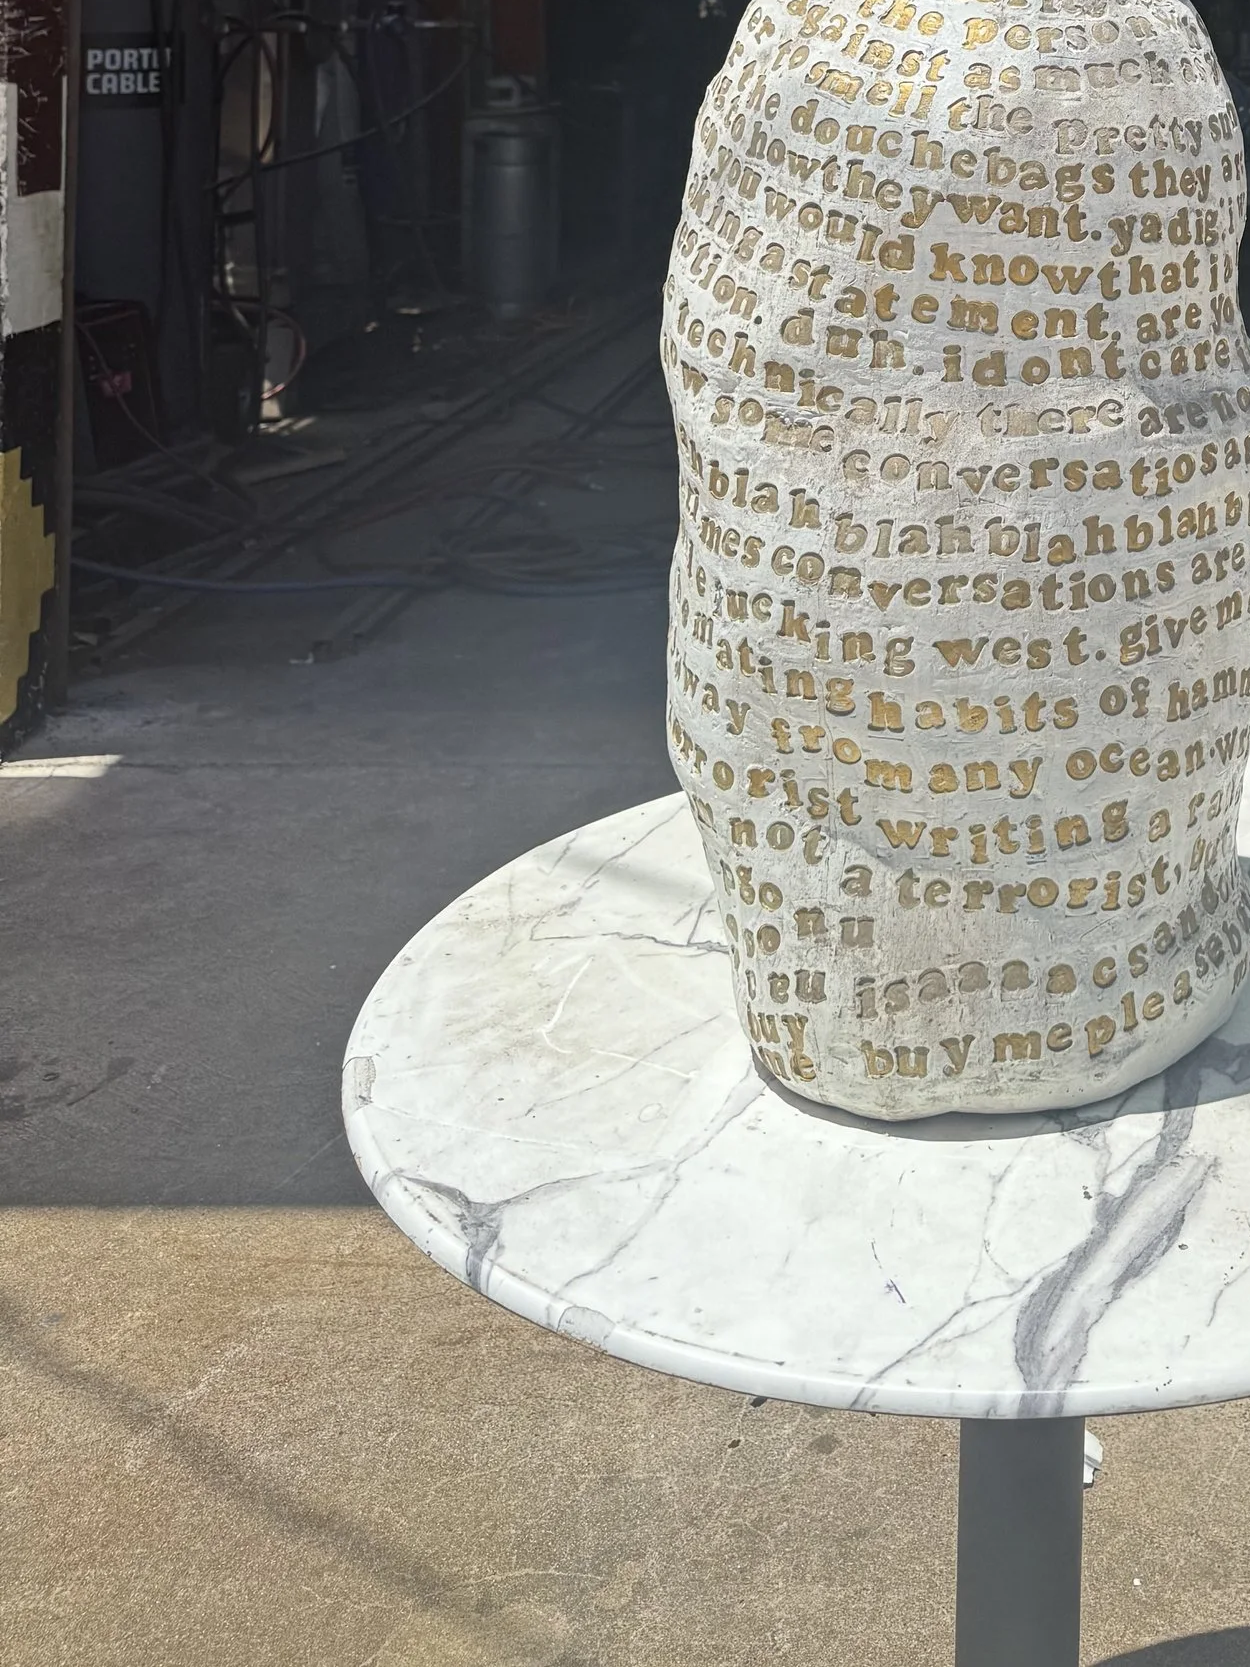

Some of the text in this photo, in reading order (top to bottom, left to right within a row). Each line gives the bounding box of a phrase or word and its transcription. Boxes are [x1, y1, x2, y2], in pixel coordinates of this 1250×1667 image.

[87, 47, 172, 70] PORT
[961, 14, 1159, 56] person
[86, 72, 161, 94] CABLE
[804, 59, 938, 124] smell
[946, 93, 1034, 137] the
[1050, 113, 1204, 158] pretty
[962, 61, 1023, 94] as
[790, 97, 1116, 204] douchebags
[1127, 157, 1212, 204] they
[764, 185, 917, 273] would
[929, 241, 1094, 297] know
[1096, 248, 1201, 302] that
[1135, 302, 1202, 345] are
[1138, 337, 1231, 382] care
[1137, 397, 1209, 438] are
[707, 459, 822, 531] blah
[834, 511, 976, 560] blah
[984, 514, 1118, 567] blah
[1123, 498, 1218, 554] blah
[770, 543, 1177, 613] conversations
[1190, 541, 1246, 585] are
[932, 625, 1108, 671] west.
[1118, 603, 1209, 667] give
[692, 610, 857, 718] mating
[867, 689, 1080, 736] habits
[1098, 675, 1152, 719] of
[770, 716, 915, 795] from
[928, 756, 1044, 800] any
[728, 814, 828, 866] not
[874, 799, 1131, 869] writing
[859, 1034, 976, 1080] buy
[993, 1022, 1074, 1063] me
